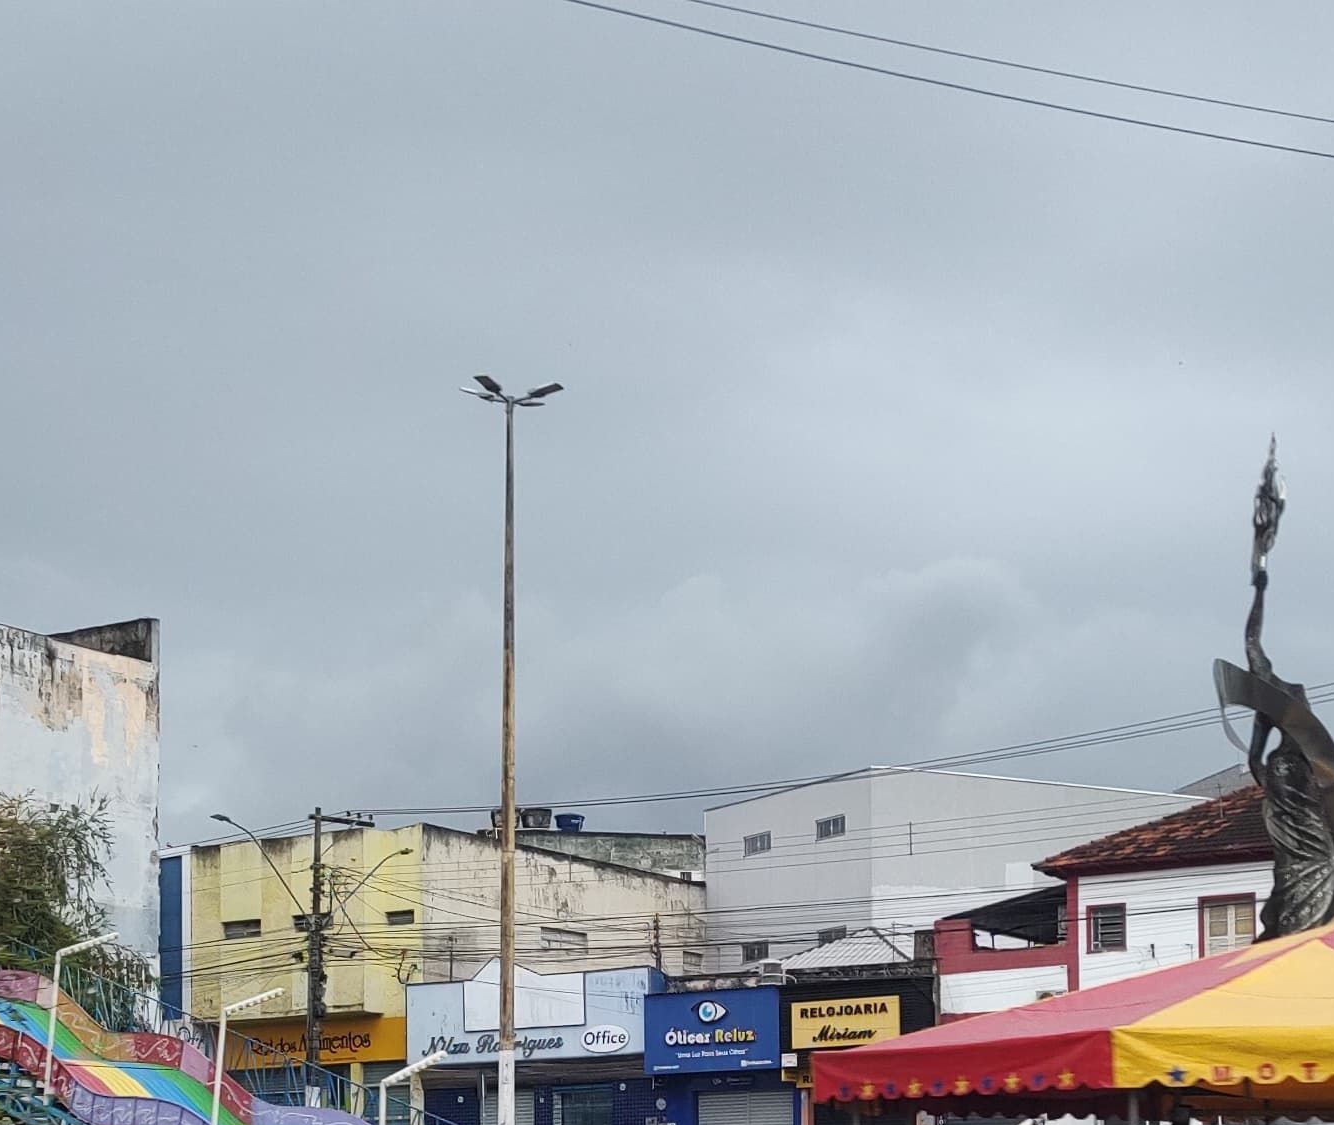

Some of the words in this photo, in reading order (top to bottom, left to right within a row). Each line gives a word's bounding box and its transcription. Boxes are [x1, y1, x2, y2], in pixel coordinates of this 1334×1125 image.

[800, 1003, 888, 1019] RELOJOARIA
[584, 1031, 627, 1046] Office
[665, 1028, 710, 1045] Óticas
[715, 1028, 756, 1043] Reluz
[812, 1025, 877, 1042] Miriam
[299, 1031, 371, 1054] Aimentos
[476, 1034, 563, 1058] Rorigues
